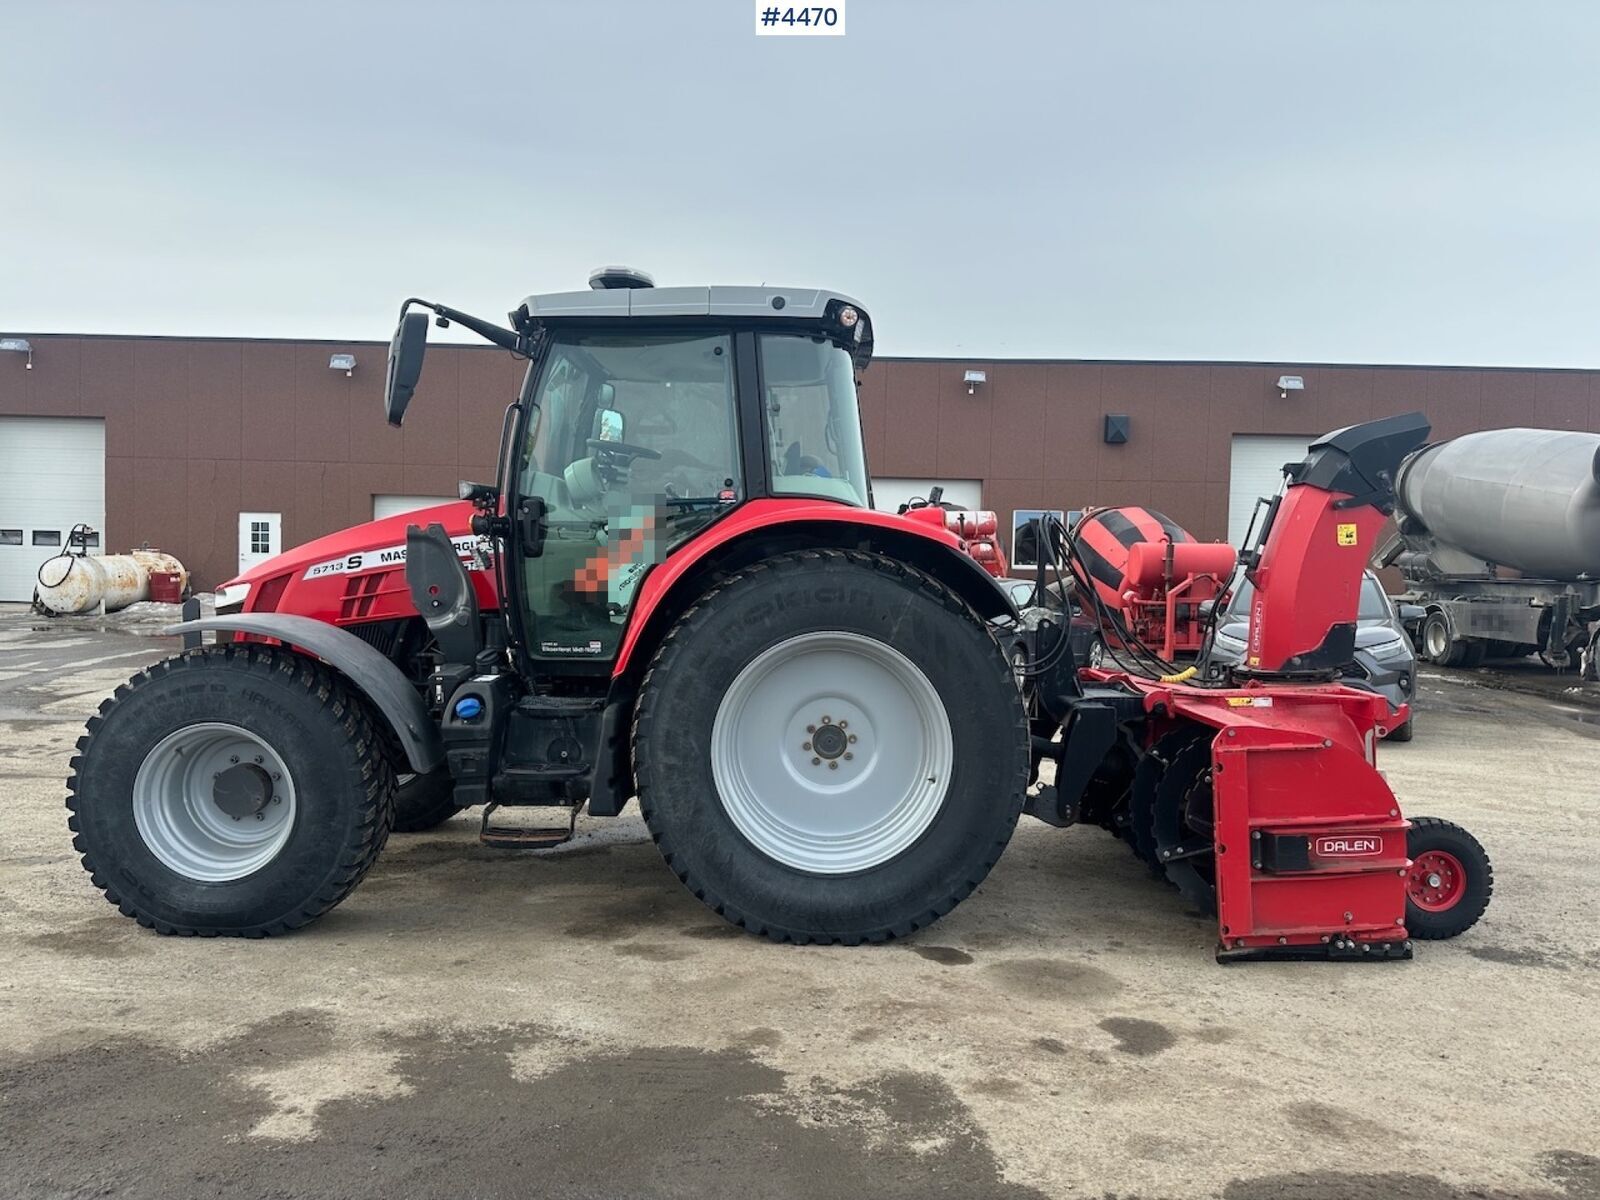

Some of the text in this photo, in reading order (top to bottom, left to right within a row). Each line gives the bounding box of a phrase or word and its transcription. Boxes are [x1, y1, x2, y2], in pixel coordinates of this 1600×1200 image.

[313, 555, 363, 576] 5713 S
[1324, 840, 1375, 852] DALEN
